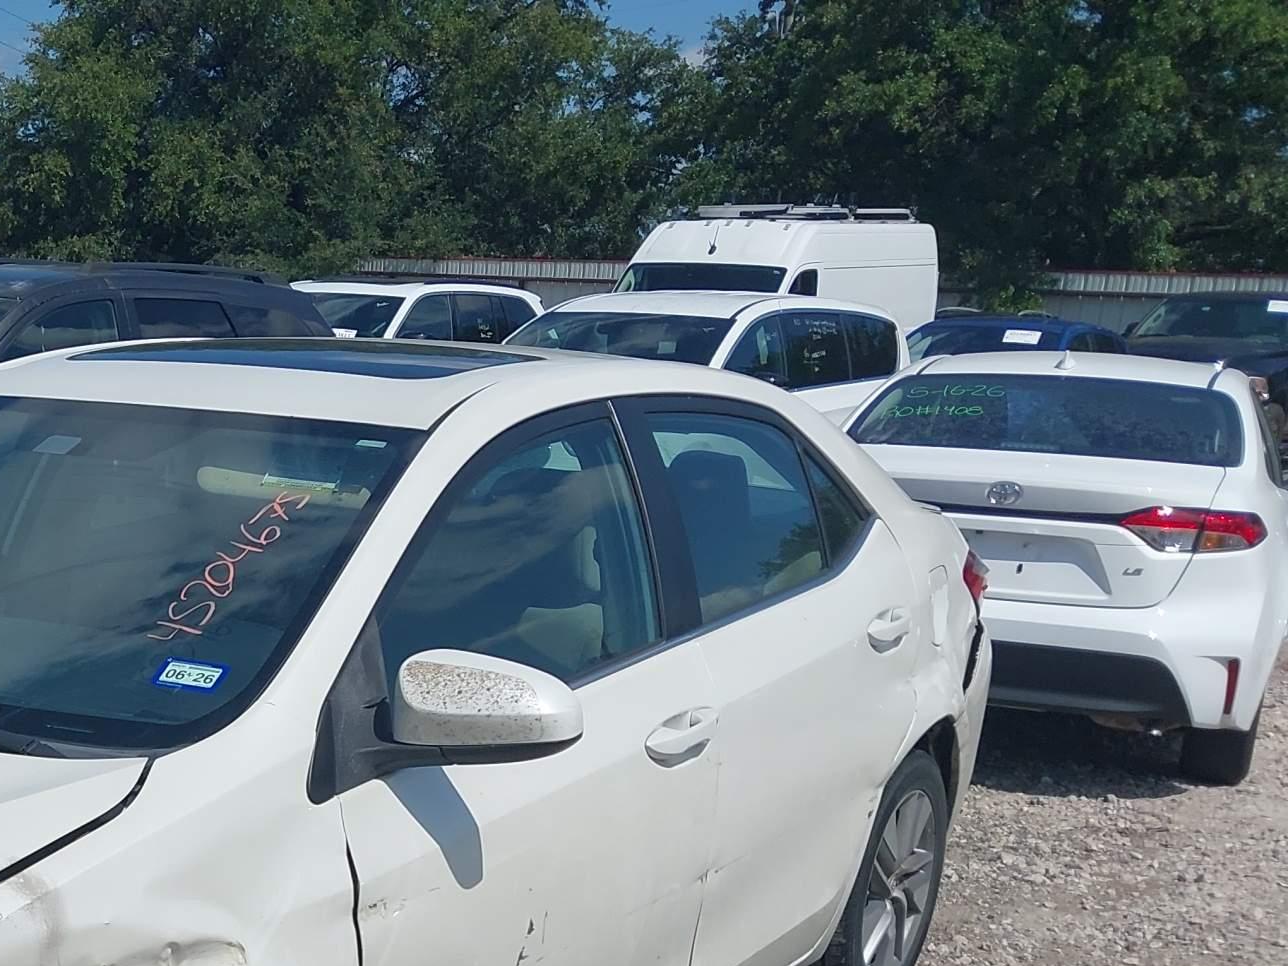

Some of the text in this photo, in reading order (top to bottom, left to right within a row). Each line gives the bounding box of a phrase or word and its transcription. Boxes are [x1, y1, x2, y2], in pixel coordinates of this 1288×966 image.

[146, 490, 311, 641] 45204675
[165, 668, 187, 681] 06
[192, 672, 216, 685] 26
